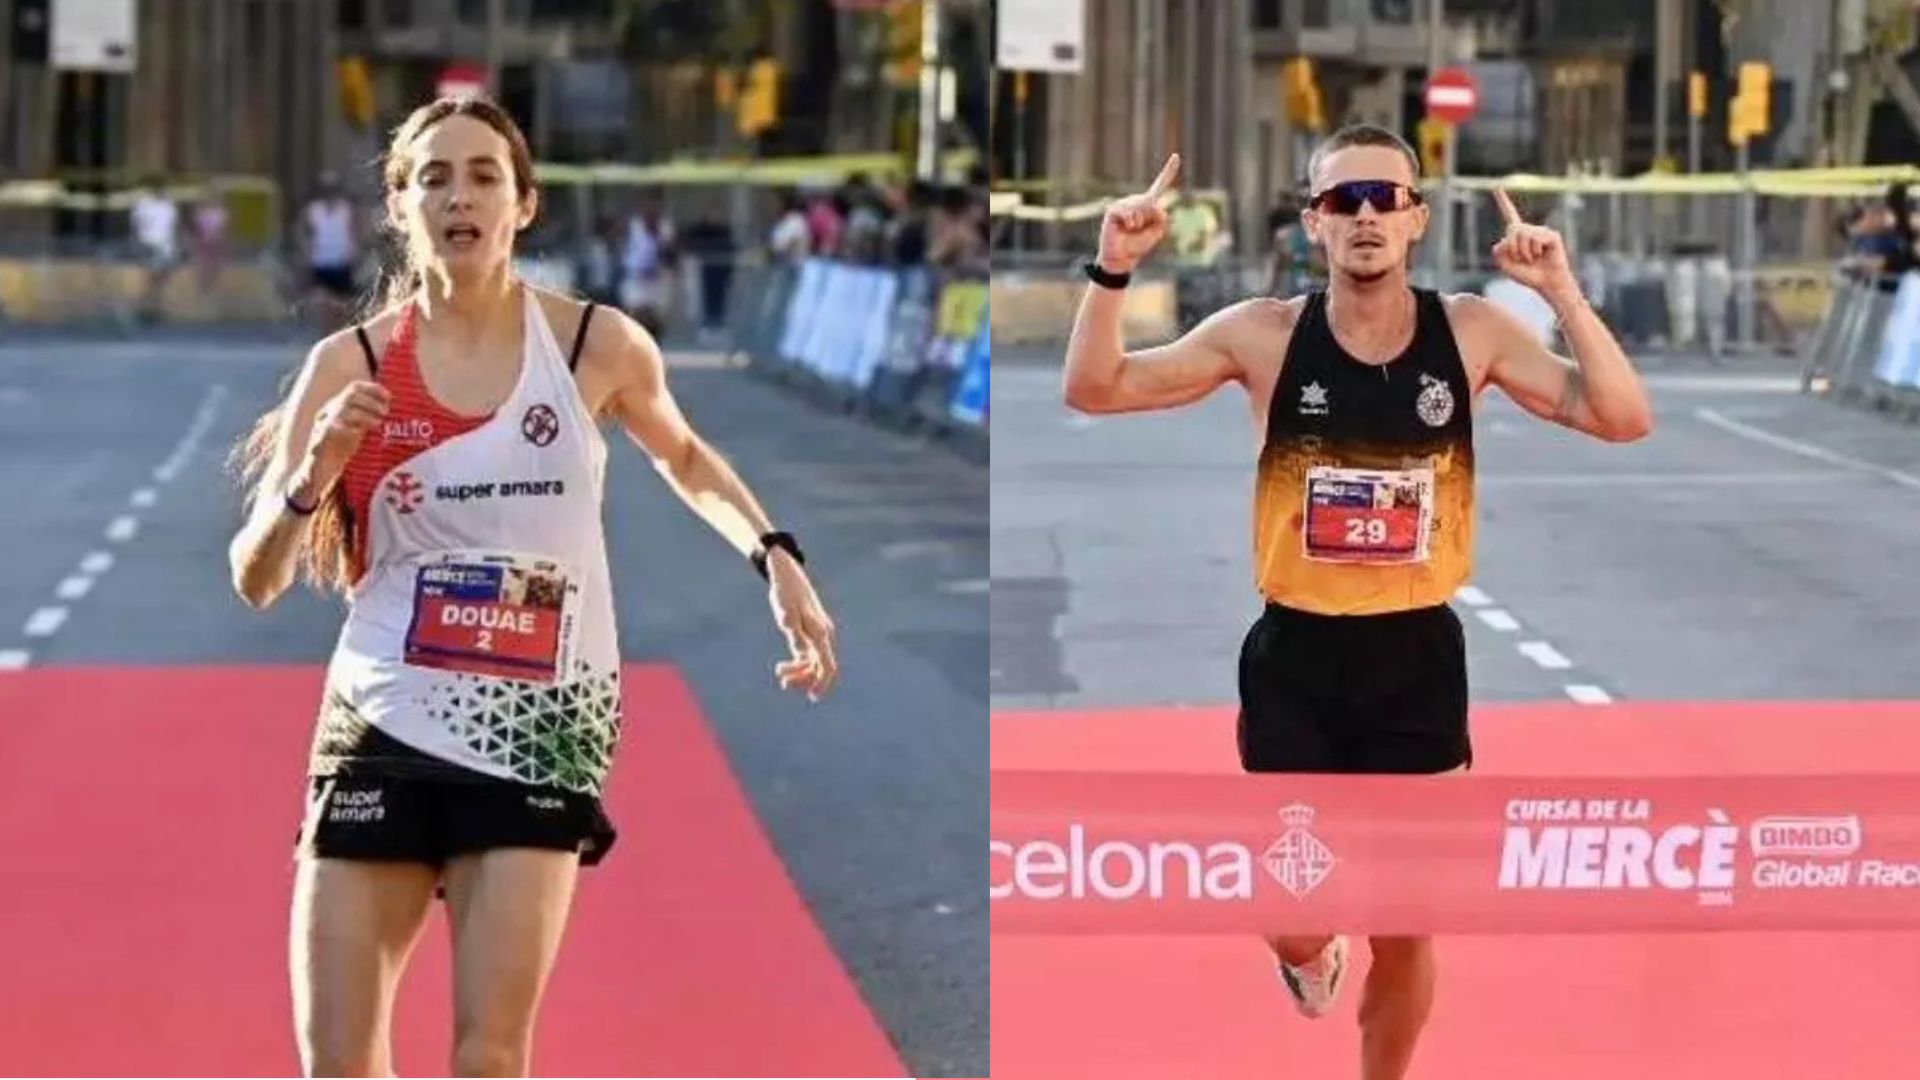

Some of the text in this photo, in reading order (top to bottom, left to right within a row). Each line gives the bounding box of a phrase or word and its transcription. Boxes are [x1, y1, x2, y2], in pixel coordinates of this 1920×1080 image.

[435, 479, 564, 500] super amara
[1345, 518, 1387, 544] 29
[441, 604, 537, 633] DOUAE
[476, 630, 493, 650] 2
[333, 789, 382, 806] super
[330, 805, 386, 822] amara
[1506, 799, 1650, 820] CURSA DE LA
[1759, 826, 1852, 847] BIMBO
[1499, 809, 1738, 889] MERCÈ
[1753, 858, 1850, 888] Global
